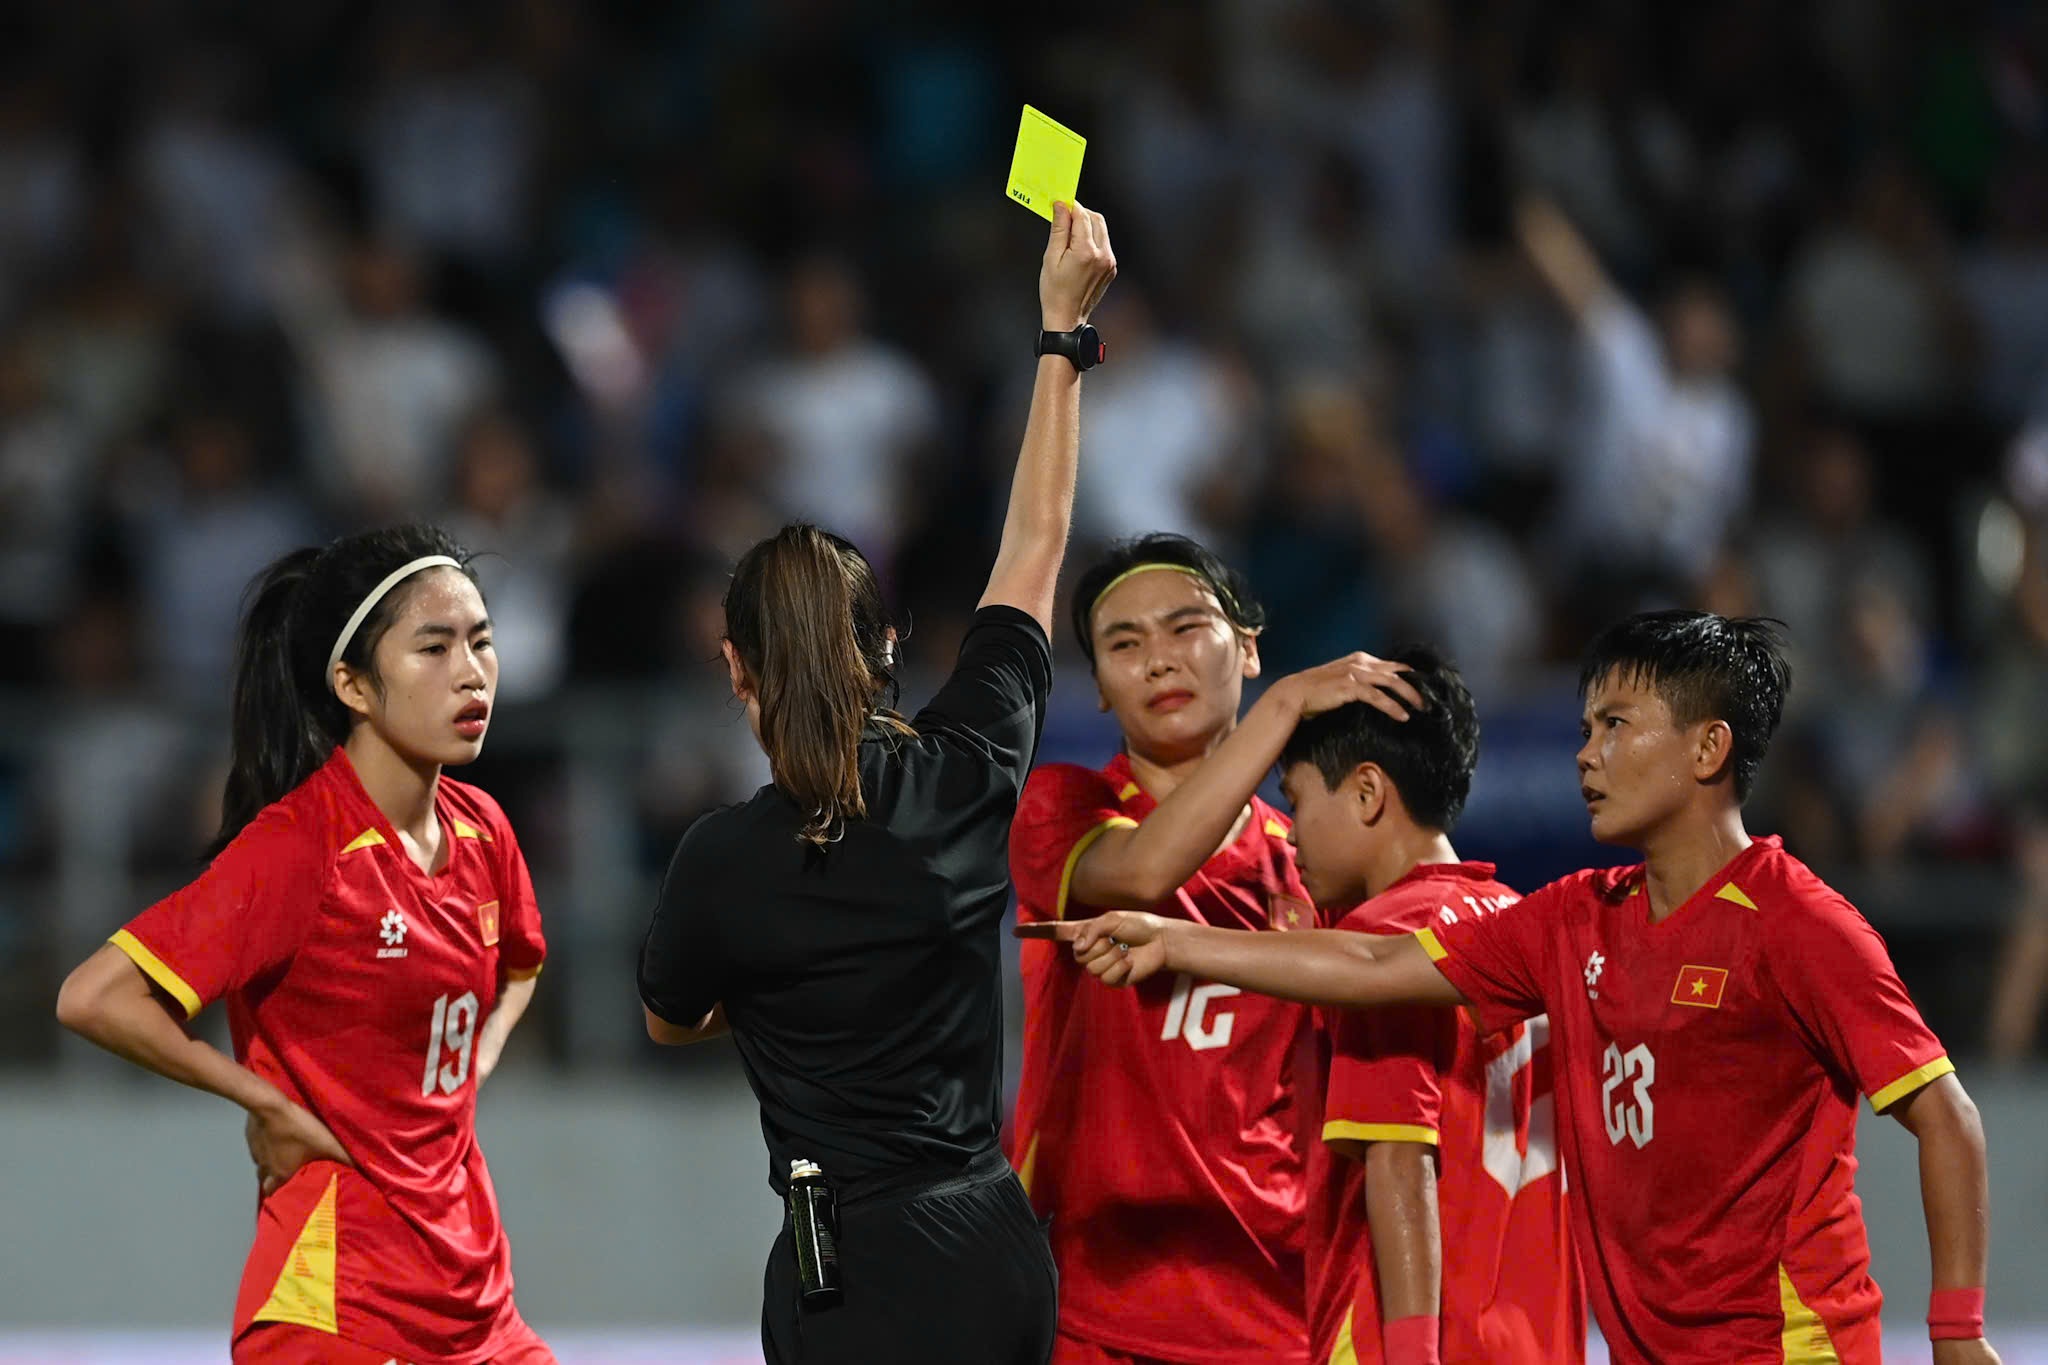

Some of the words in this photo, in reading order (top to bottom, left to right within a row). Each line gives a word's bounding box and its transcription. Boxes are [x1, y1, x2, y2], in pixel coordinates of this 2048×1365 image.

[1013, 189, 1030, 204] FIFA
[422, 990, 480, 1098] 19
[1160, 976, 1242, 1051] 16
[1602, 1040, 1655, 1150] 23
